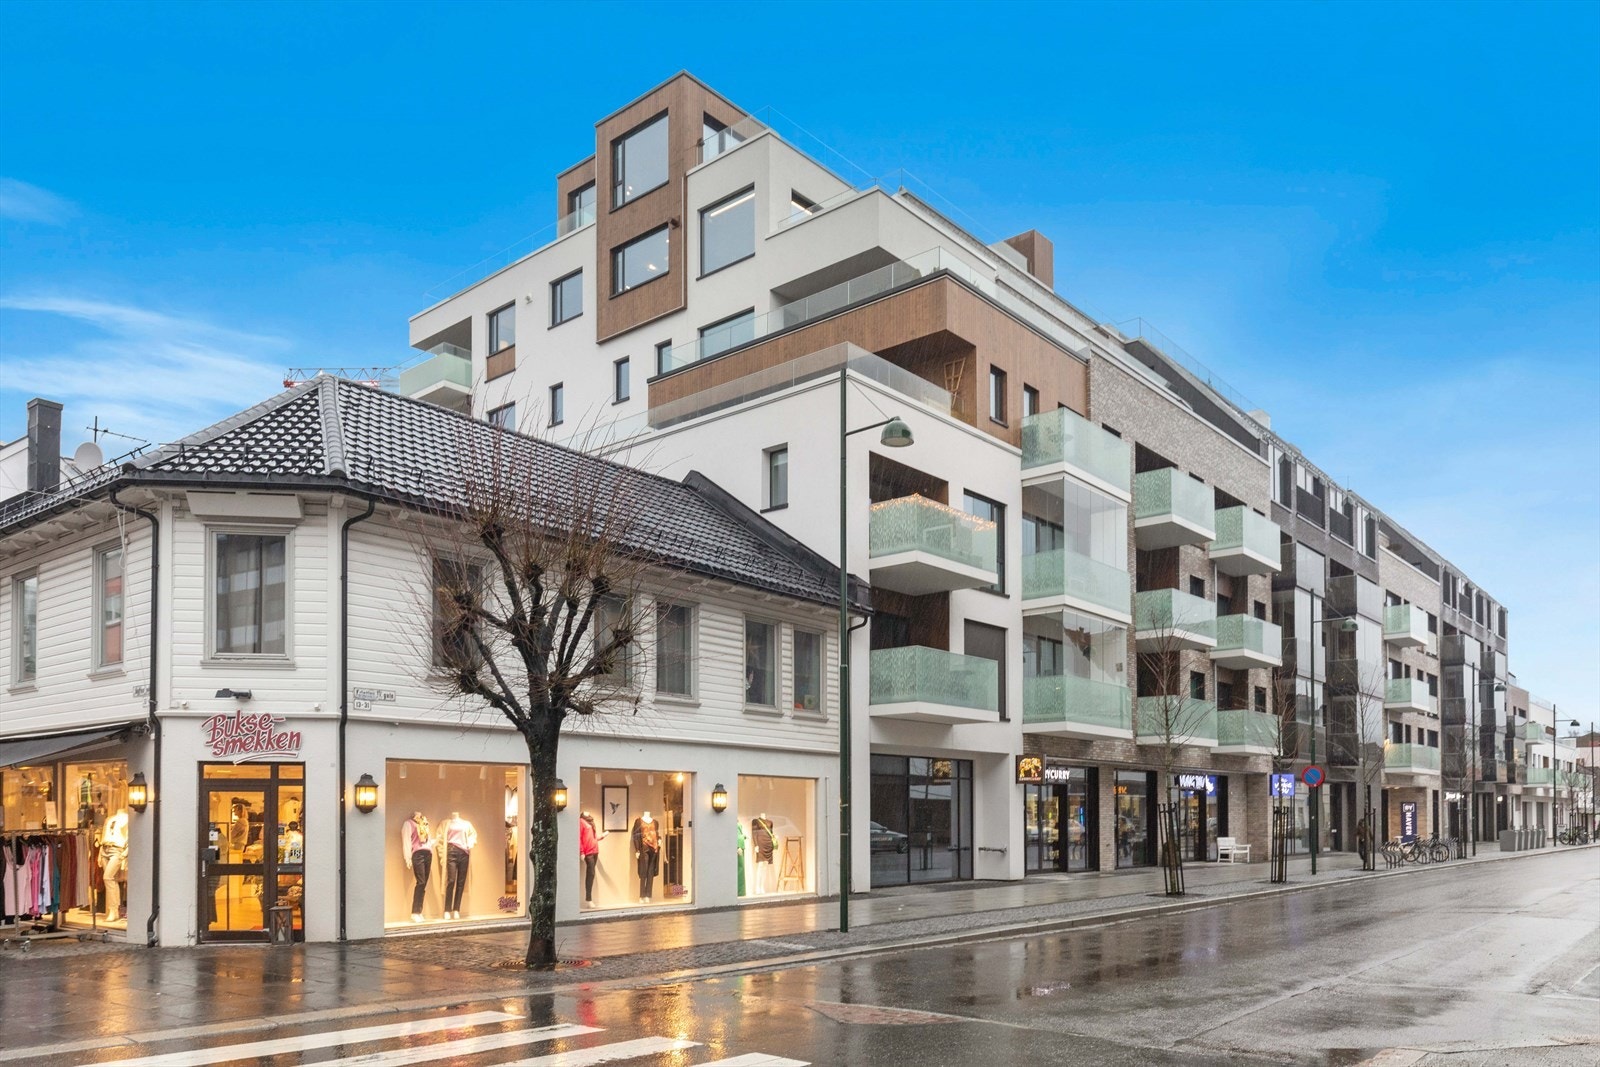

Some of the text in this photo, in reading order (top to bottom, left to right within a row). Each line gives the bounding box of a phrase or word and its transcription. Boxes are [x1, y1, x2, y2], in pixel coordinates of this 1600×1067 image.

[201, 709, 285, 744] Bukse-
[212, 728, 301, 756] smekken
[1405, 811, 1413, 836] HAVEN
